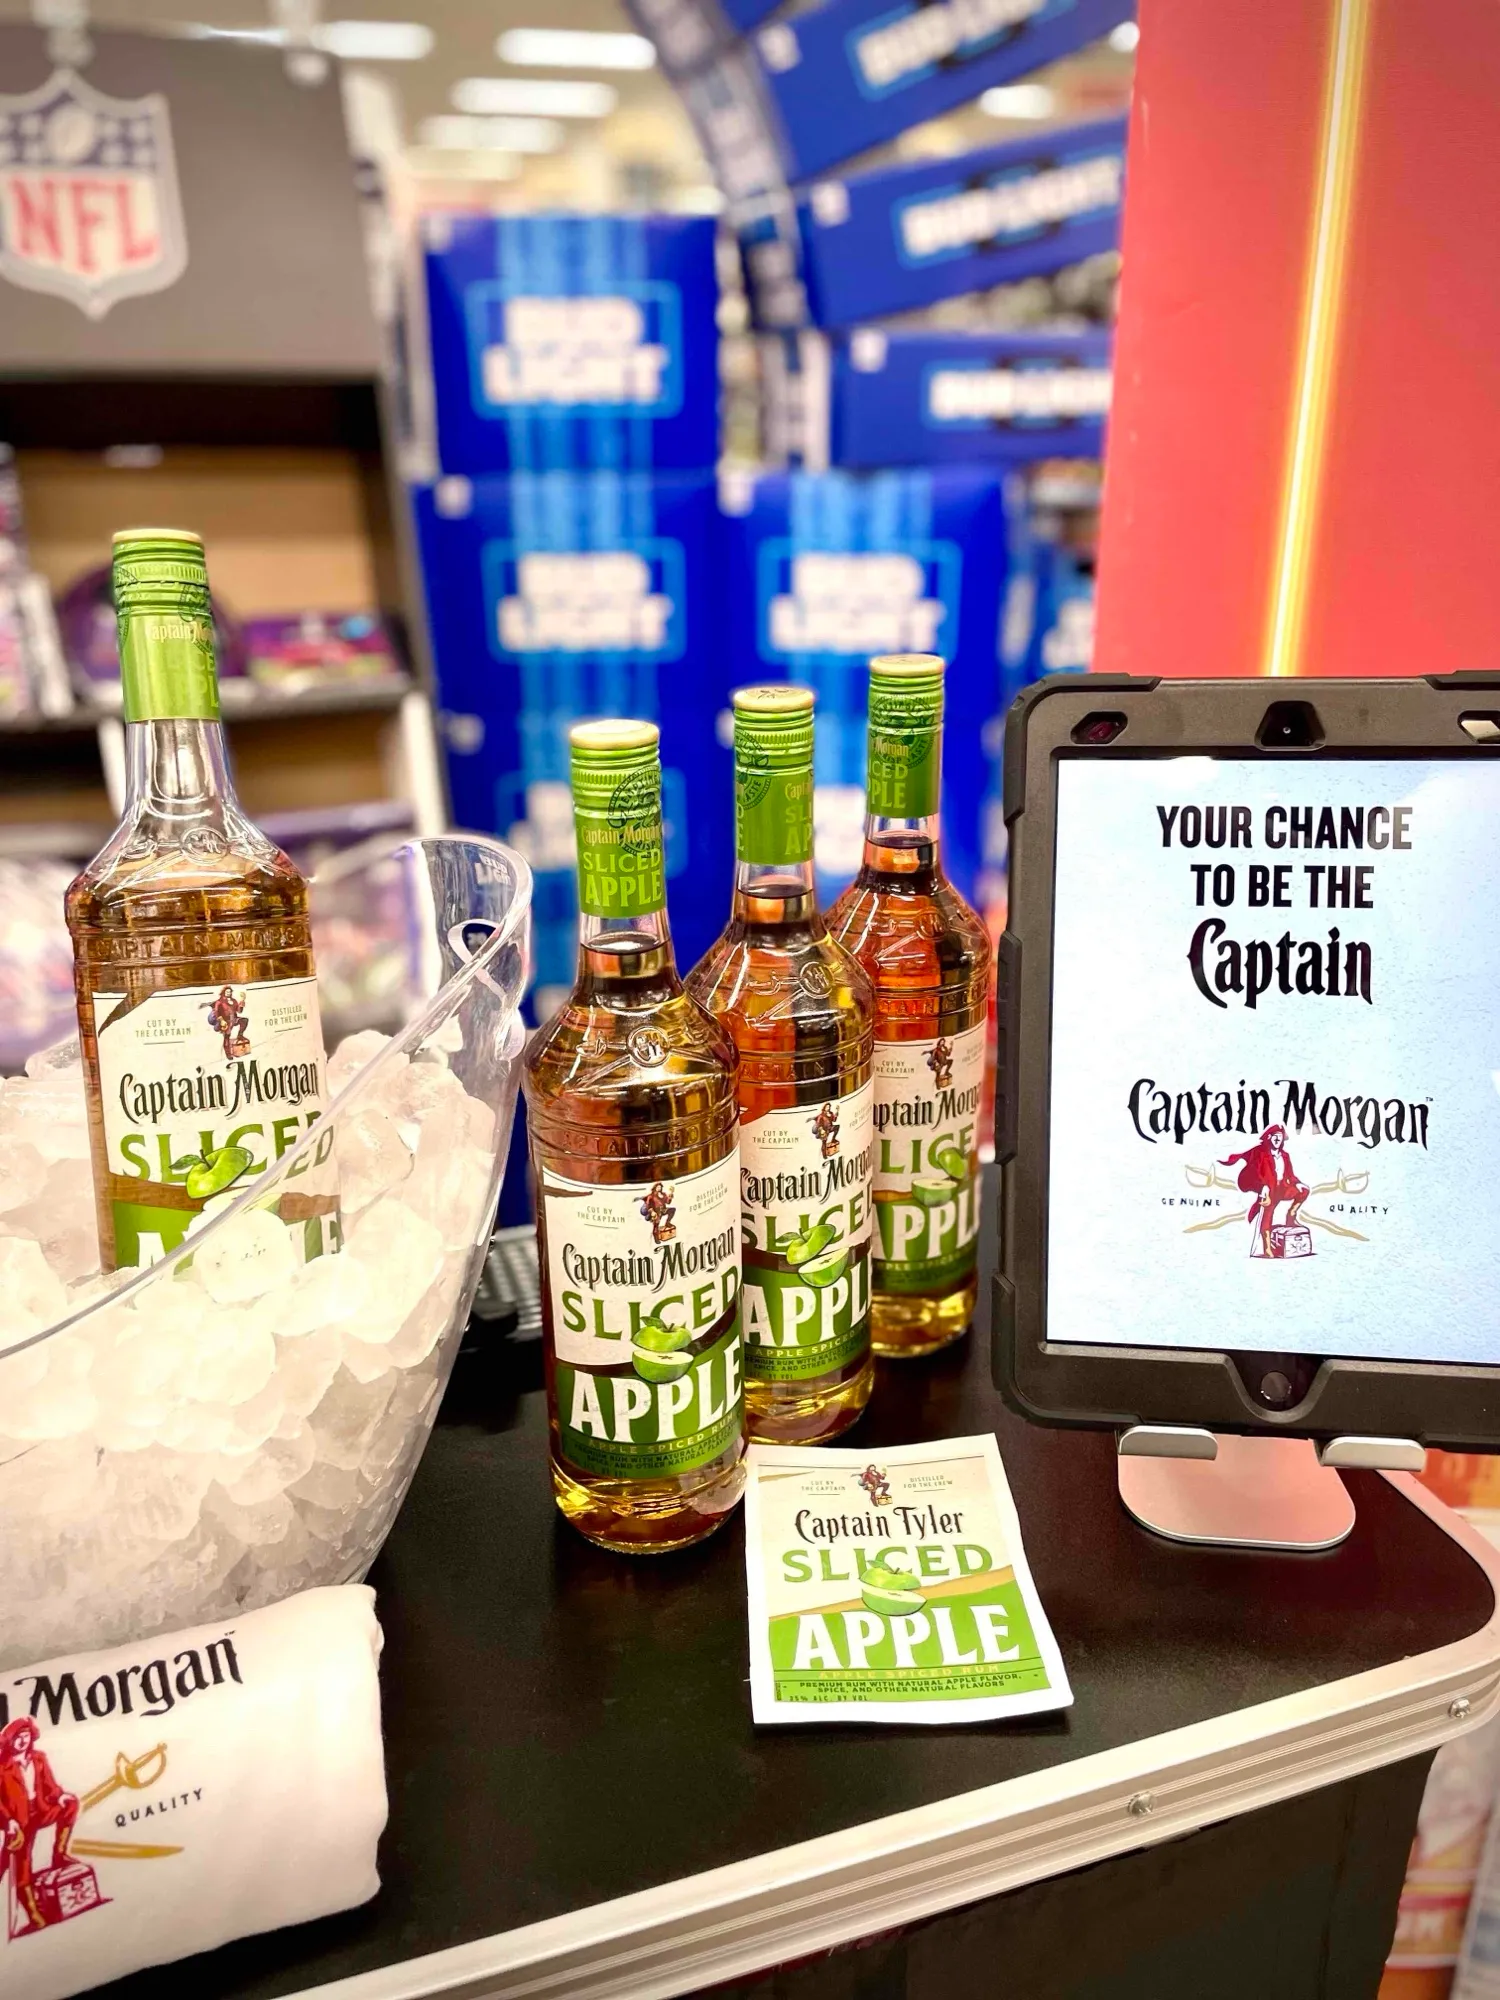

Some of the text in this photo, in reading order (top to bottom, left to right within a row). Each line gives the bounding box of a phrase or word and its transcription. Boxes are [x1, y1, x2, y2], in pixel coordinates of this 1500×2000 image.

[10, 174, 160, 275] NFL
[743, 779, 762, 803] ASTE
[583, 826, 621, 846] Captain
[1157, 805, 1413, 850] YOUR CHANCE
[583, 848, 661, 873] SLICED
[585, 870, 662, 908] APPLE
[1190, 864, 1375, 909] TO BE THE
[1187, 918, 1373, 1010] Captain
[264, 1018, 279, 1026] FOR
[281, 1015, 293, 1024] THE
[272, 1005, 303, 1017] DISTILLED
[135, 1028, 192, 1038] THE CAPTAIN
[166, 1019, 177, 1027] BY
[119, 1066, 226, 1124] Captain
[1127, 1078, 1273, 1145] Captain
[696, 1183, 724, 1202] DISTILLED
[603, 1207, 613, 1215] BY
[689, 1201, 702, 1213] FOR
[703, 1197, 715, 1207] THE
[1161, 1198, 1221, 1208] GENUINE
[1329, 1204, 1389, 1215] QUALITY
[577, 1212, 626, 1223] THE CAPTAIN
[562, 1243, 654, 1289] Captain
[562, 1265, 740, 1341] SLICED
[755, 1348, 805, 1357] APPLE
[797, 1356, 817, 1364] WITH
[801, 1360, 826, 1370] OTHER
[569, 1336, 741, 1442] APPLE
[589, 1440, 639, 1454] APPLE
[647, 1433, 705, 1453] SPICED
[711, 1414, 734, 1435] RUM
[656, 1447, 698, 1462] NATURAL
[794, 1504, 965, 1544] Captain Tyler
[782, 1543, 993, 1583] SLICED
[792, 1604, 1020, 1670] APPLE
[819, 1664, 1000, 1680] APPLE SPICED RUM
[946, 1676, 977, 1684] APPLE
[912, 1684, 958, 1692] NATURAL
[960, 1680, 1005, 1690] FLAVORS
[115, 1787, 204, 1828] QUALITY
